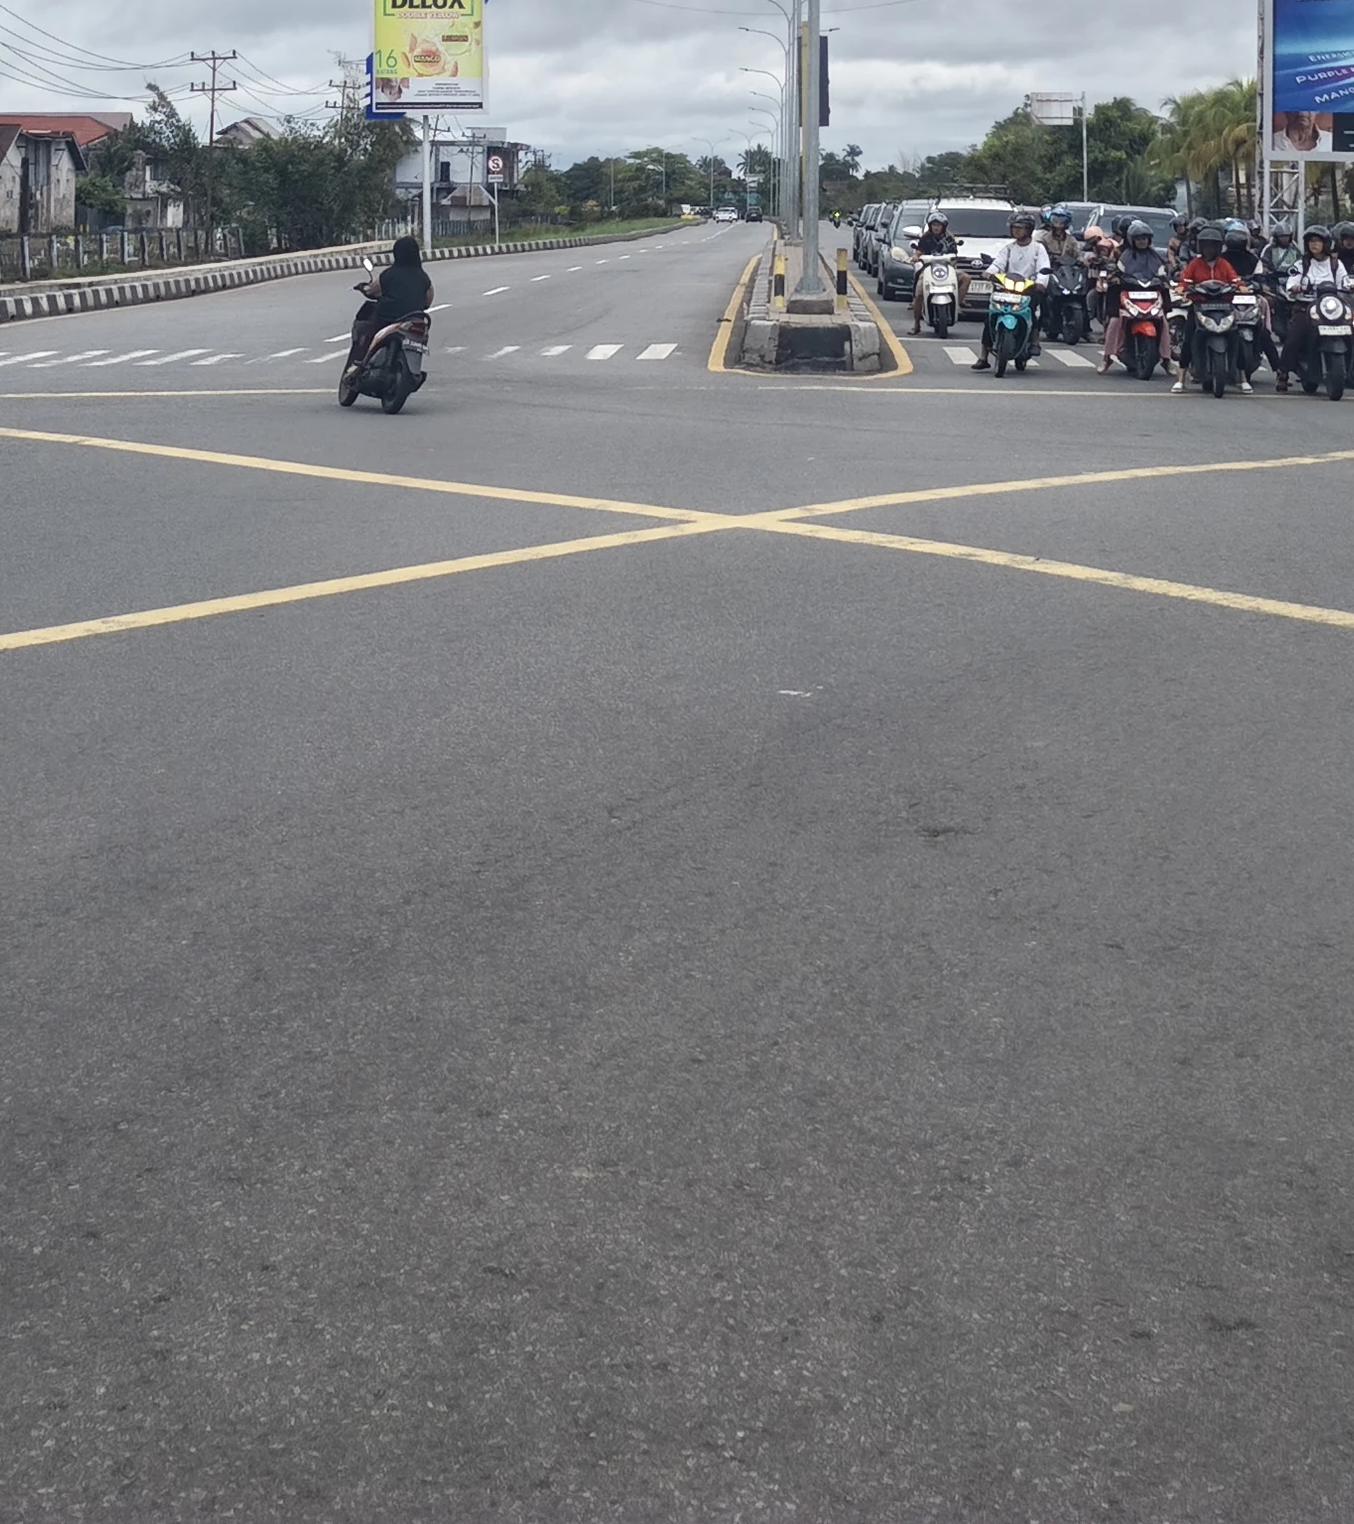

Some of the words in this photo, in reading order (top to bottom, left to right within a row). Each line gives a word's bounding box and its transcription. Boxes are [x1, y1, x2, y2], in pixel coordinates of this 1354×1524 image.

[375, 48, 398, 69] 16
[1296, 68, 1349, 84] PURPLE
[492, 158, 500, 169] S
